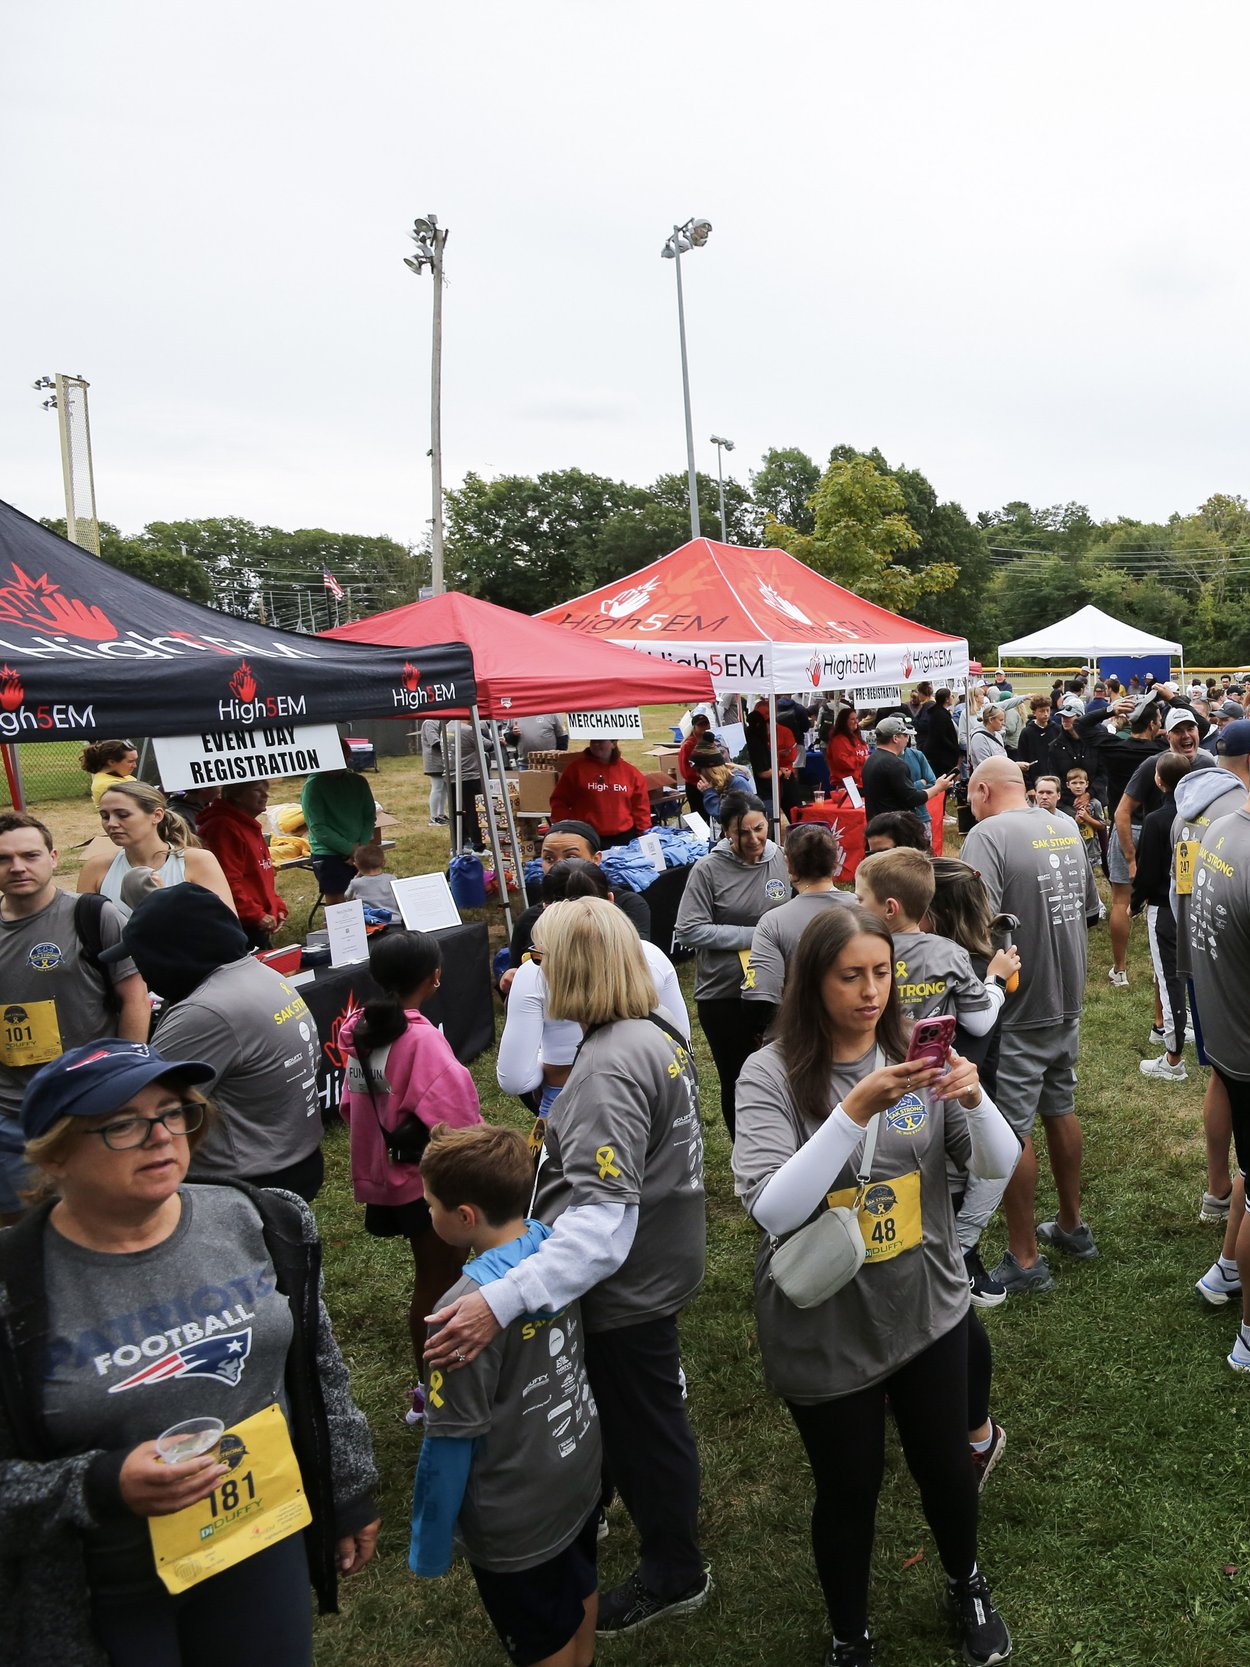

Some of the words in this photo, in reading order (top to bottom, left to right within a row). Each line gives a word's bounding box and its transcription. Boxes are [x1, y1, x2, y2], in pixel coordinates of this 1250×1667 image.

[557, 613, 730, 634] High5EM
[648, 652, 765, 678] h5EM
[823, 653, 877, 681] High5EM
[912, 650, 953, 673] High5EM
[392, 683, 456, 710] High5EM
[218, 695, 307, 724] High5EM
[568, 713, 640, 730] MERCHANDISE
[201, 729, 257, 753] EVENT
[264, 726, 297, 747] DAY
[190, 749, 321, 785] REGISTRATION
[1032, 840, 1050, 849] SAK
[1180, 861, 1190, 874] 247
[1208, 853, 1235, 878] STRONG
[897, 981, 945, 997] TRONG
[273, 1005, 295, 1025] SAK
[6, 1026, 33, 1043] 101
[350, 1067, 364, 1079] FUN
[371, 1069, 383, 1080] UN
[888, 1112, 900, 1121] SAK
[900, 1105, 923, 1115] STRONG
[871, 1217, 896, 1244] 48
[873, 1239, 904, 1255] DUFFY
[46, 1265, 274, 1377] PATRIOTS
[93, 1304, 256, 1376] FOOTBALL
[221, 1446, 247, 1458] TRONG
[208, 1470, 256, 1518] 181
[213, 1497, 263, 1529] DUFFY
